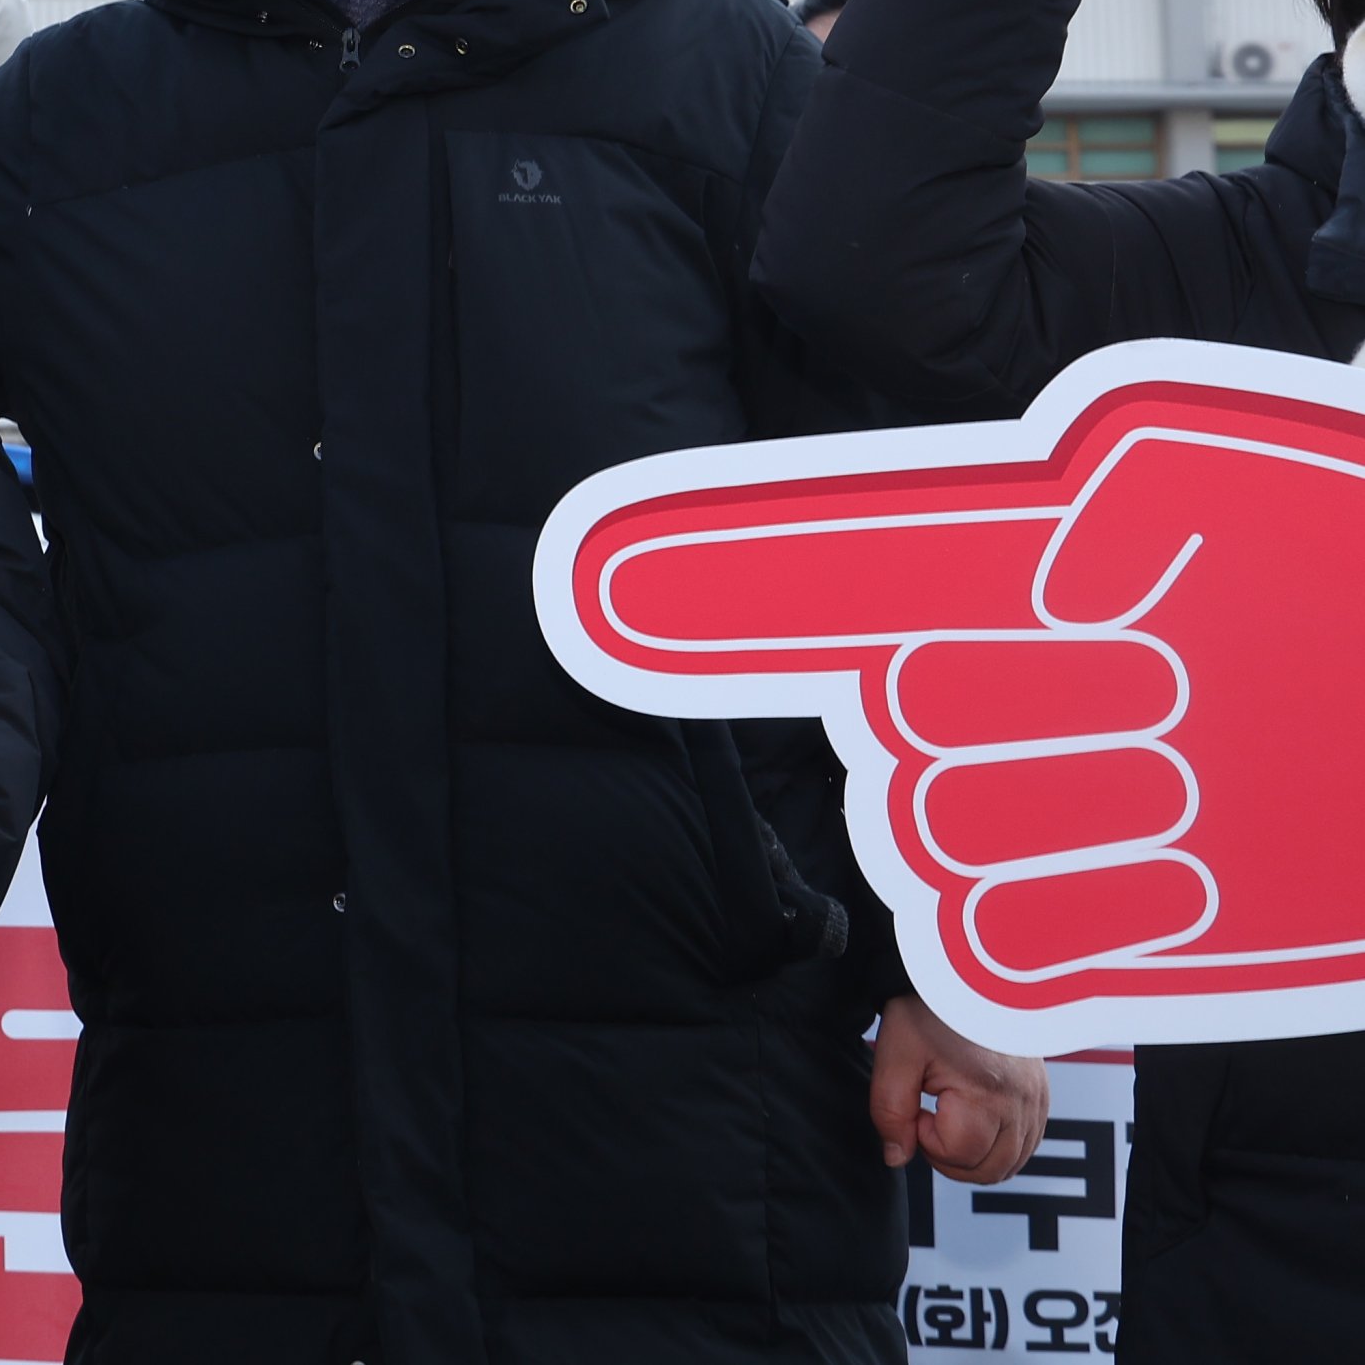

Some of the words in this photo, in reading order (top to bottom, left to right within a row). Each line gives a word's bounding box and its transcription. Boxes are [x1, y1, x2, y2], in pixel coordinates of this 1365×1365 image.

[498, 193, 536, 203] BLACK
[538, 194, 562, 205] YAK
[904, 1285, 1008, 1351] (화)
